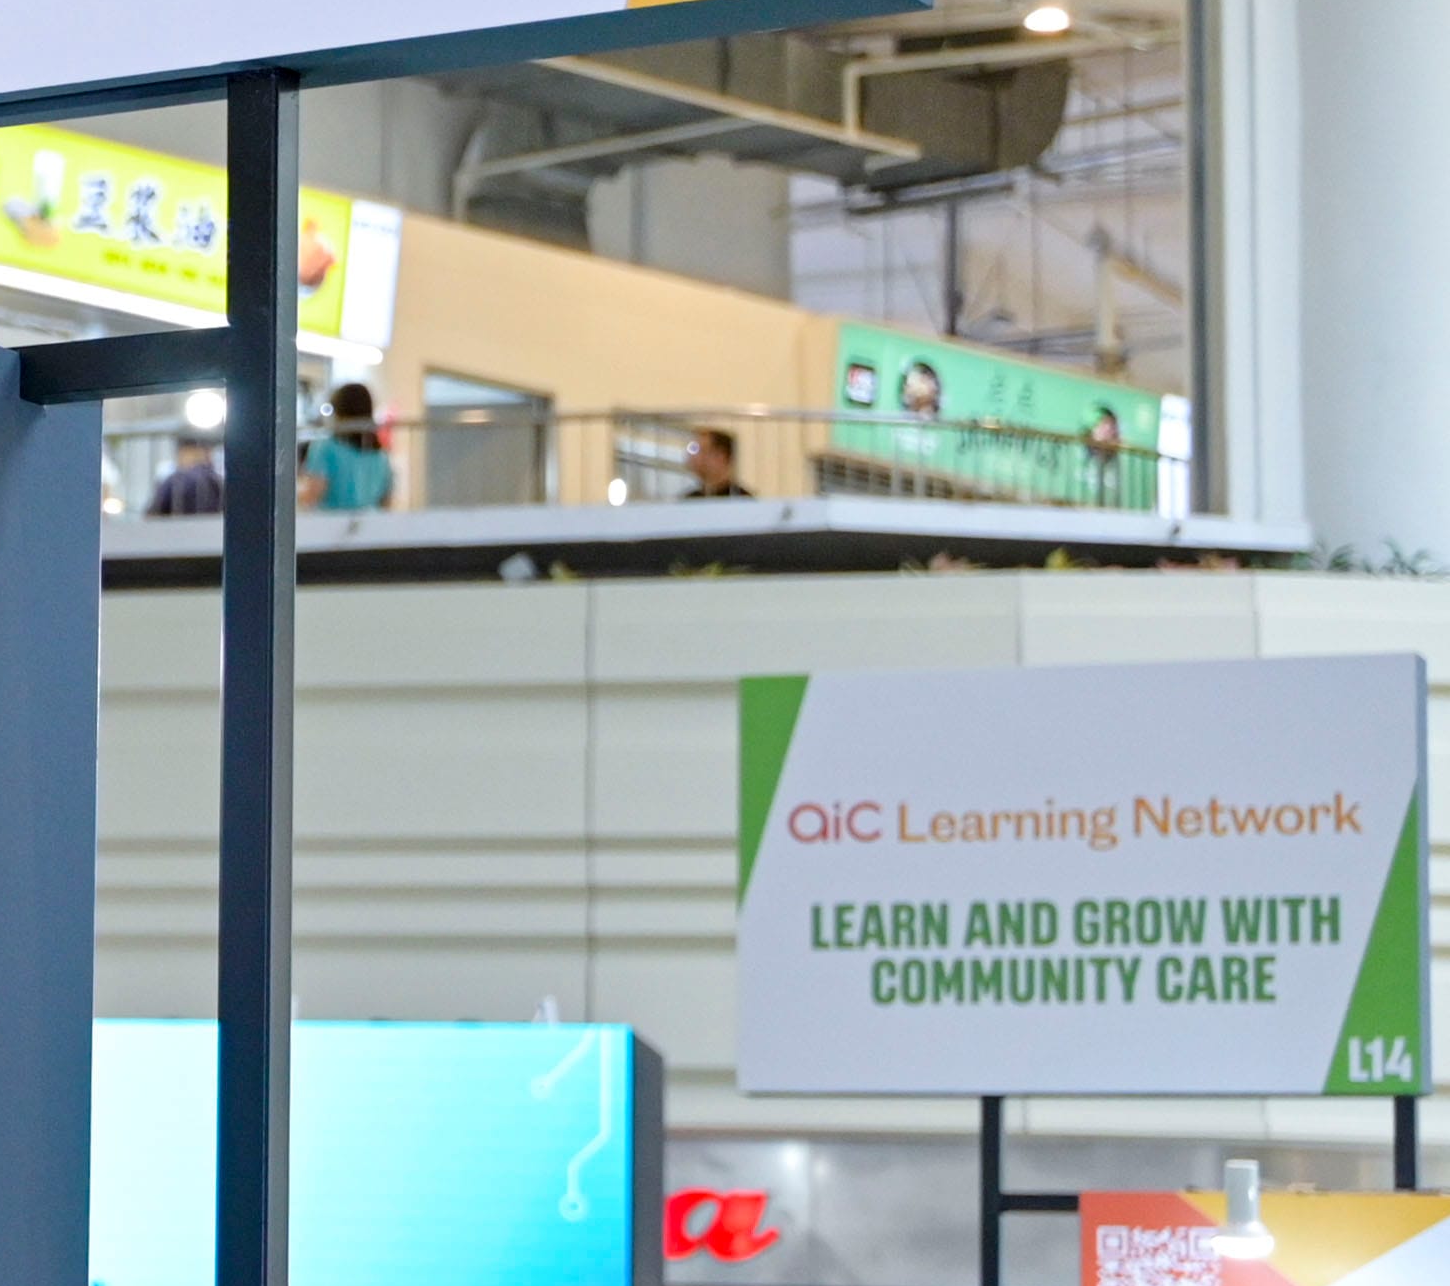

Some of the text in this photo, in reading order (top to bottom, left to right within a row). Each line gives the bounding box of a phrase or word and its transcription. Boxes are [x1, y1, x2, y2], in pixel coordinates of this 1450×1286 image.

[898, 799, 1118, 850] Learning
[1133, 792, 1363, 837] Network
[811, 896, 1341, 950] LEARN AND GROW WITH
[871, 955, 1277, 1006] COMMUNITY CARE
[1347, 1036, 1413, 1082] L14
